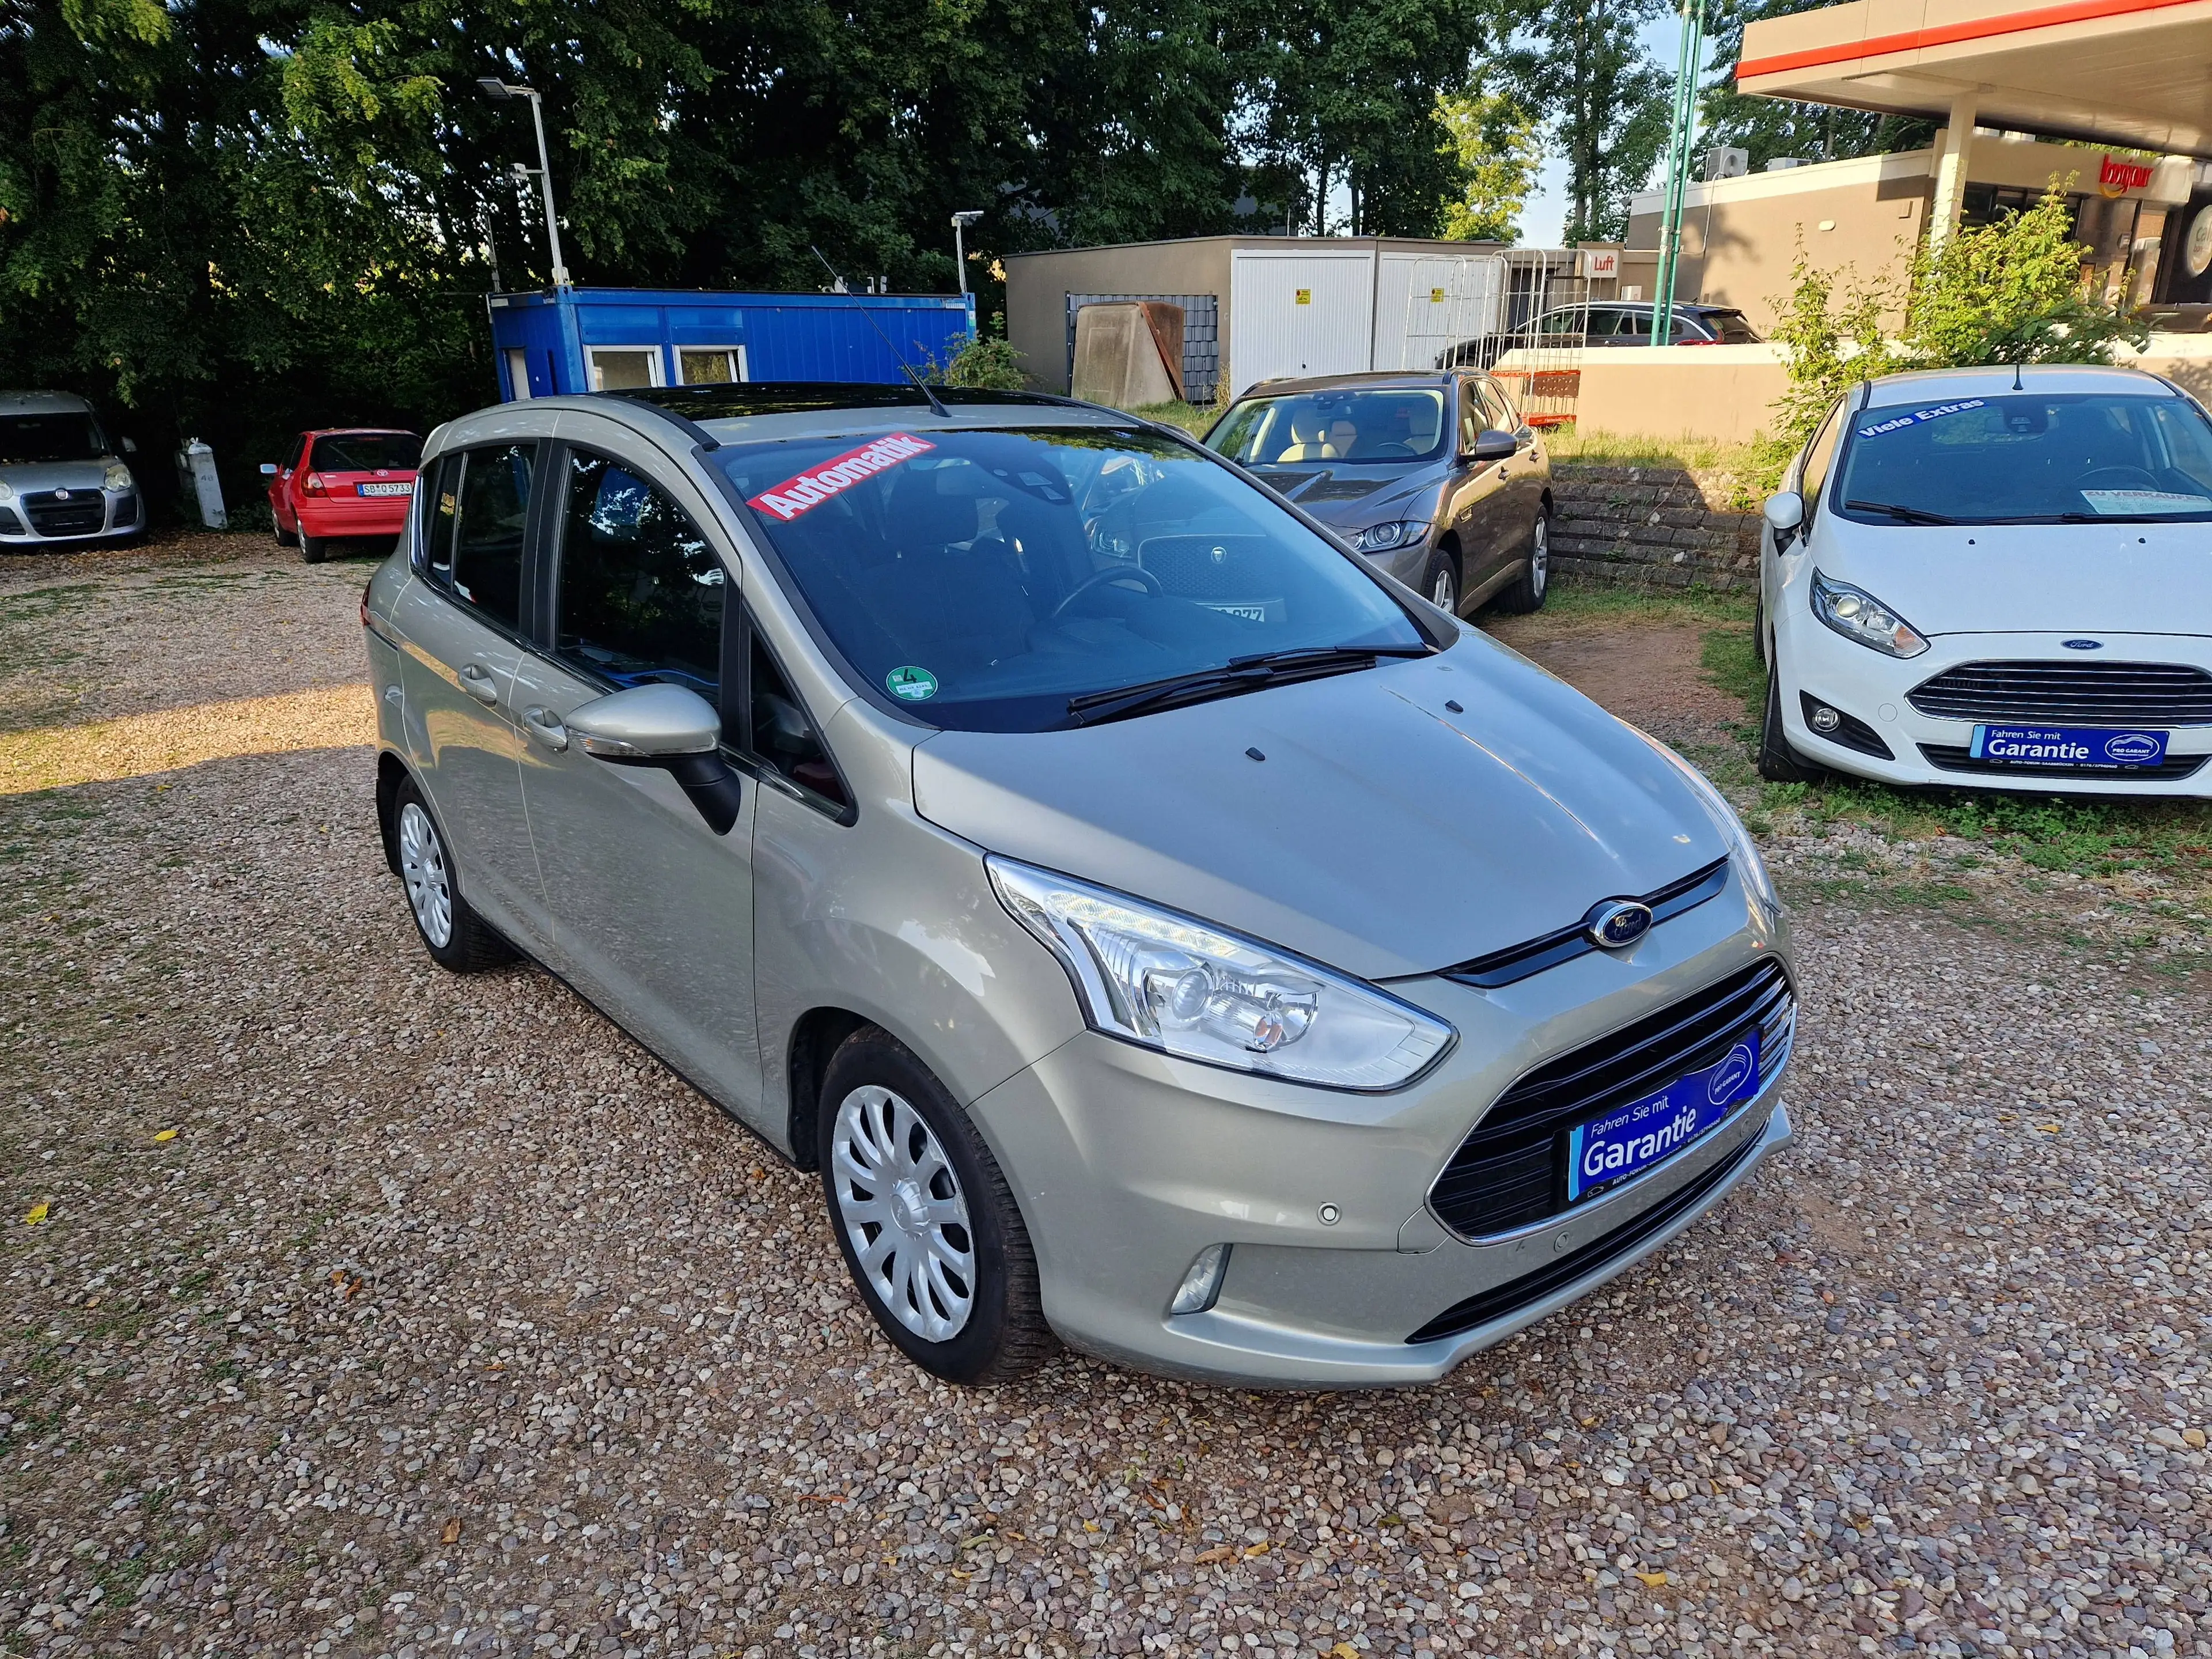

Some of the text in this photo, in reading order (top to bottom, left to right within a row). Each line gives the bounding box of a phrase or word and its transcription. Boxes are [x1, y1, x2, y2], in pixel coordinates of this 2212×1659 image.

[2099, 153, 2154, 194] bonjour
[1594, 256, 1615, 271] Luft
[1859, 399, 1984, 437] Viele Extras
[364, 485, 376, 493] SB
[389, 484, 410, 493] 5733
[759, 436, 932, 518] Automatik
[903, 668, 917, 683] 4
[1991, 730, 2061, 740] Fahren Sie mit
[1988, 739, 2089, 759] Garantie
[1614, 912, 1642, 938] Ford
[1722, 1071, 1741, 1087] GARANT
[1591, 1095, 1669, 1138] Fahren Sie mit
[1584, 1105, 1696, 1176] Garantie
